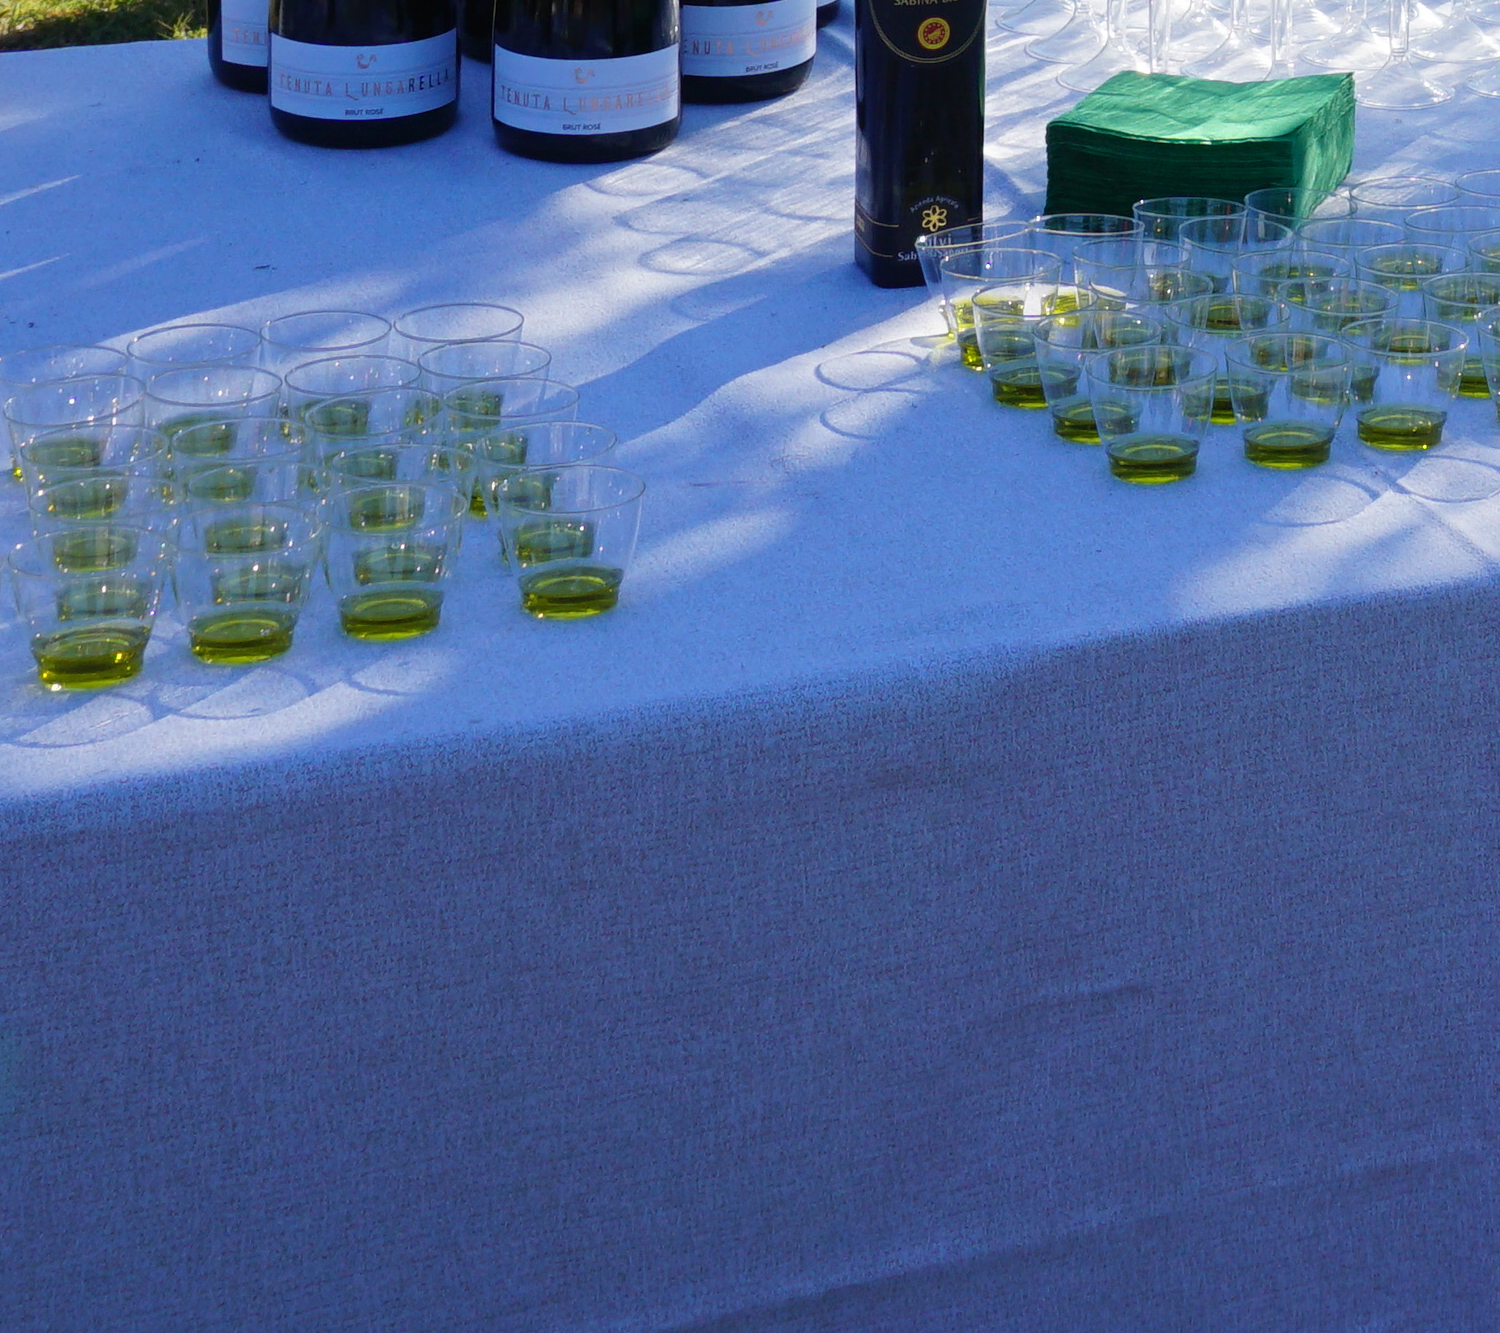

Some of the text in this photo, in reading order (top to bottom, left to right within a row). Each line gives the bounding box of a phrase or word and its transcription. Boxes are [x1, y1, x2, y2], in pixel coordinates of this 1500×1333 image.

[745, 64, 764, 73] BRUT
[278, 69, 449, 101] TENUTA LUNGARELLA
[501, 84, 551, 111] TENUTA
[344, 109, 364, 117] BRUT
[562, 121, 601, 131] BRUT ROSÉ
